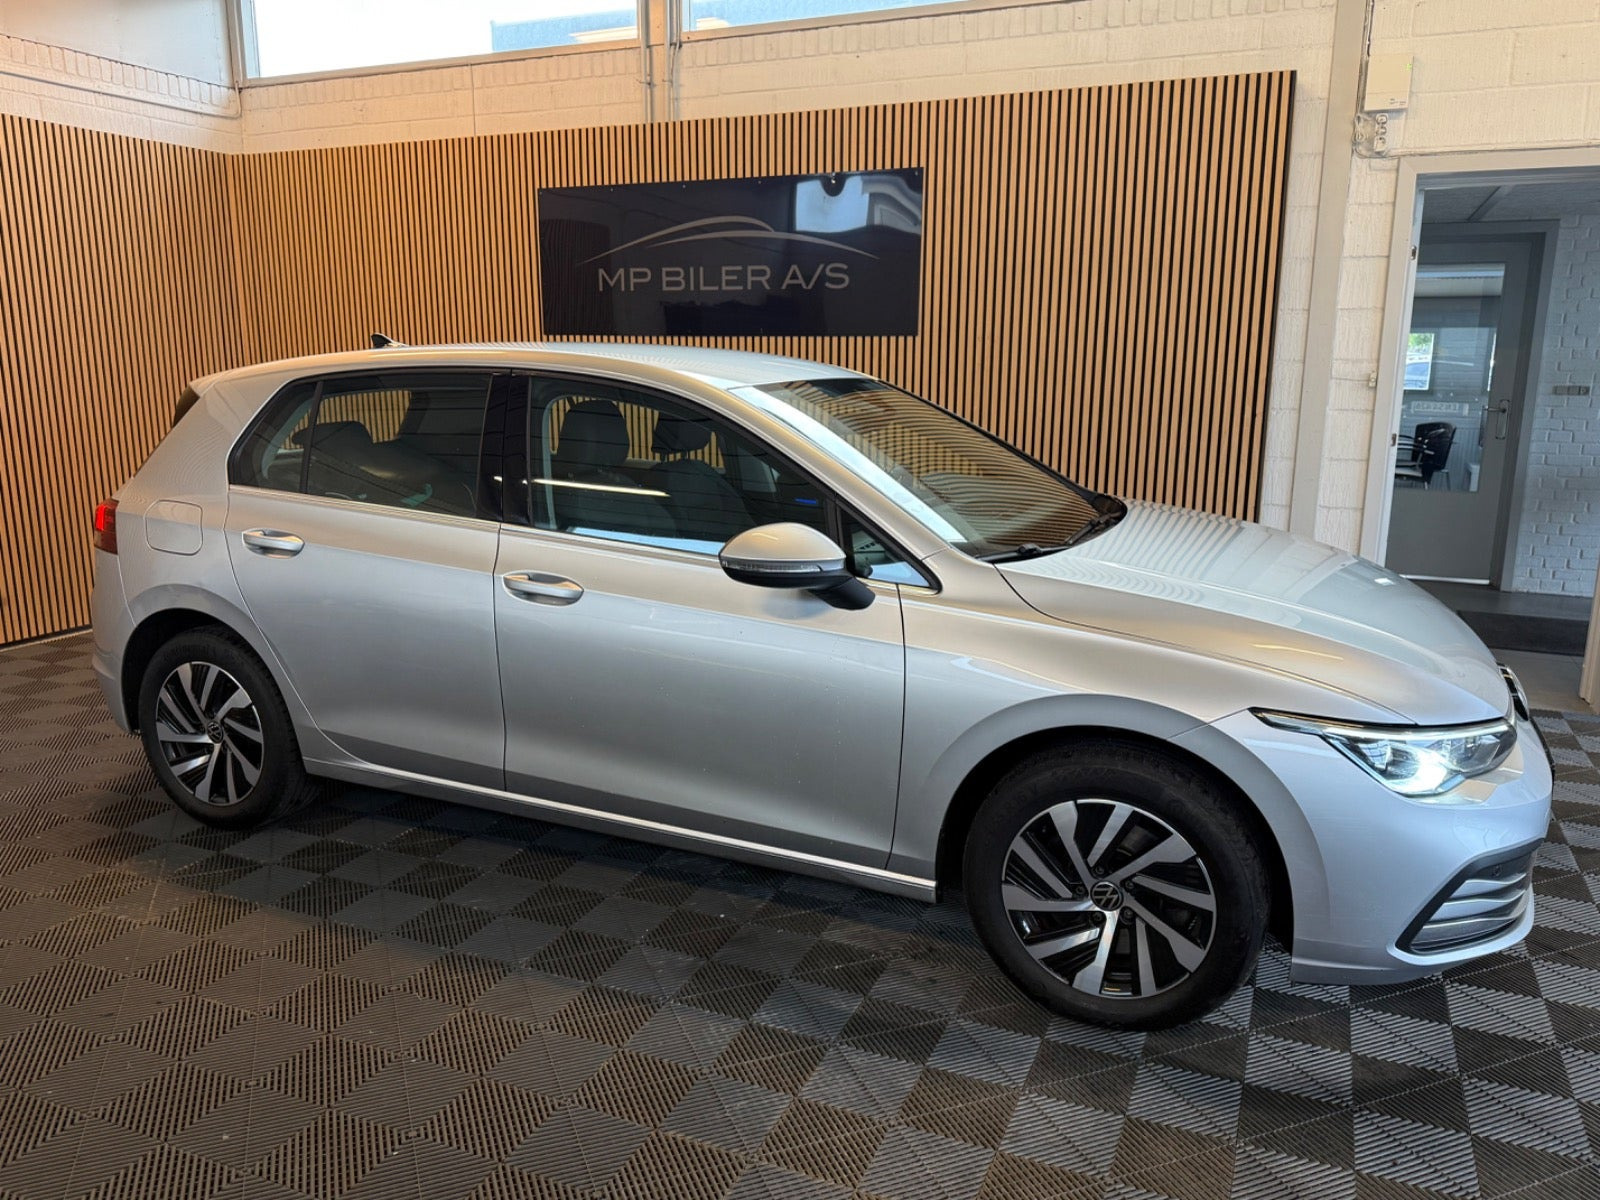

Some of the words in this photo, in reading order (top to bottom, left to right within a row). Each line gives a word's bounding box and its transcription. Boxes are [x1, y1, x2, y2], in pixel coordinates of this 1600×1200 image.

[597, 268, 651, 291] MP
[661, 266, 770, 291] BILER
[781, 263, 850, 290] A/S
